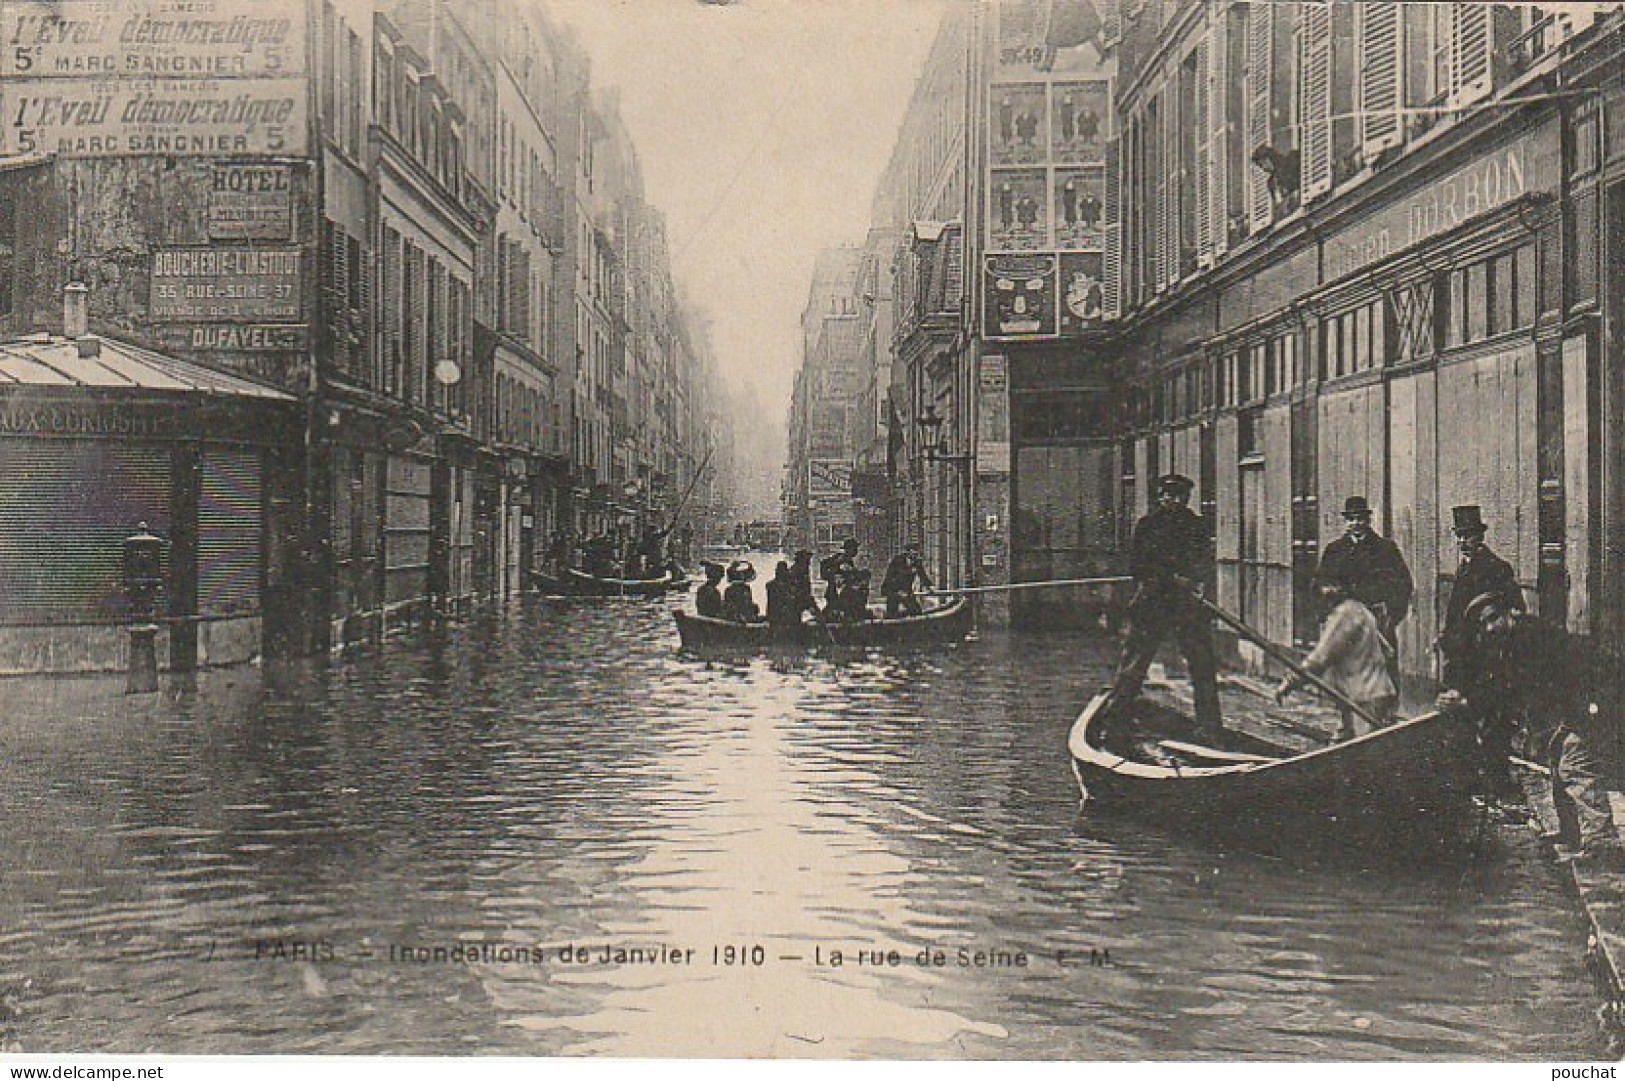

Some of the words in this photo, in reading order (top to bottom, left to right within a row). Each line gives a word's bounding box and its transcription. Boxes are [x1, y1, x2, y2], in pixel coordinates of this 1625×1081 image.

[55, 55, 116, 70] MARC
[126, 55, 245, 71] SANGNIER
[58, 135, 118, 152] MARC
[128, 134, 247, 151] SANGNIER
[213, 169, 288, 193] HOTEL
[158, 284, 177, 298] 35
[191, 328, 275, 347] DUFAYEL
